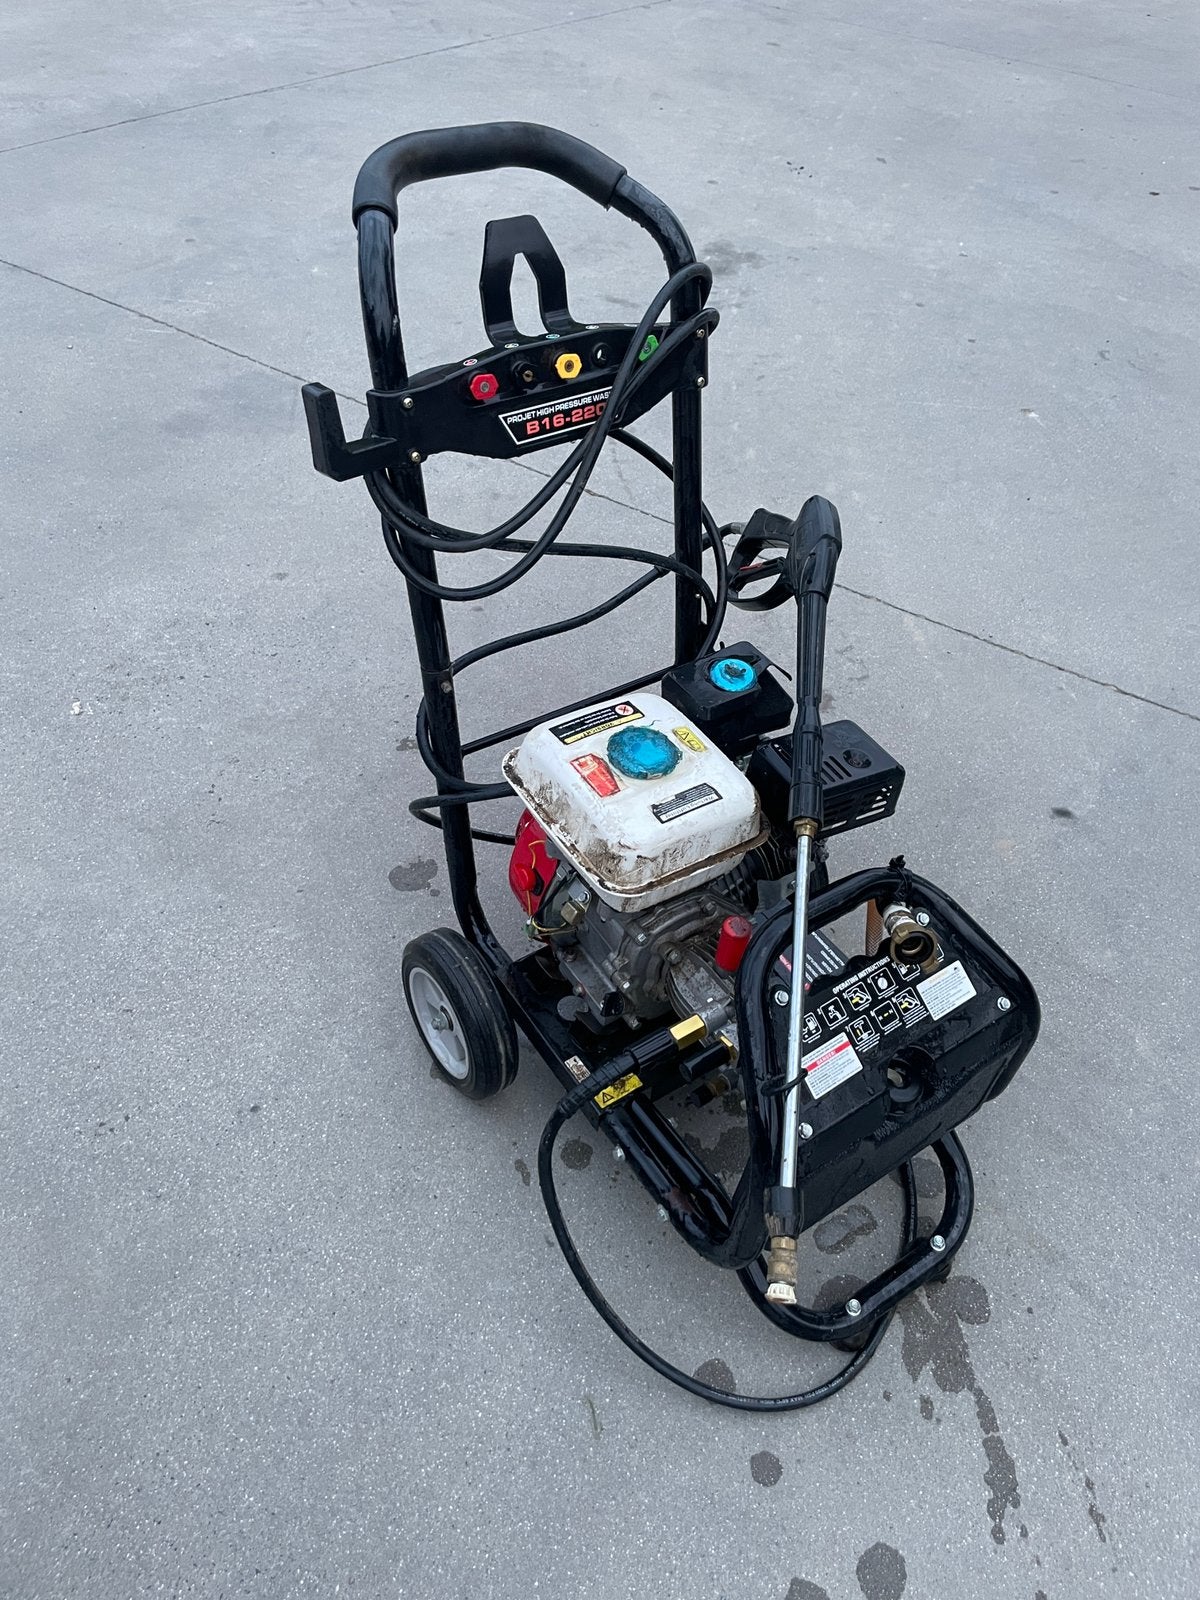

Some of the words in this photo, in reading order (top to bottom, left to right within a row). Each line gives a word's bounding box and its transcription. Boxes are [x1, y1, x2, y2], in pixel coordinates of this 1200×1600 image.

[507, 410, 536, 425] PROJET
[536, 406, 555, 417] HIGH
[555, 396, 592, 412] PRESSURE
[592, 391, 611, 402] WAS
[832, 974, 859, 994] OPERATING
[857, 956, 891, 979] INSTRUCTIONS
